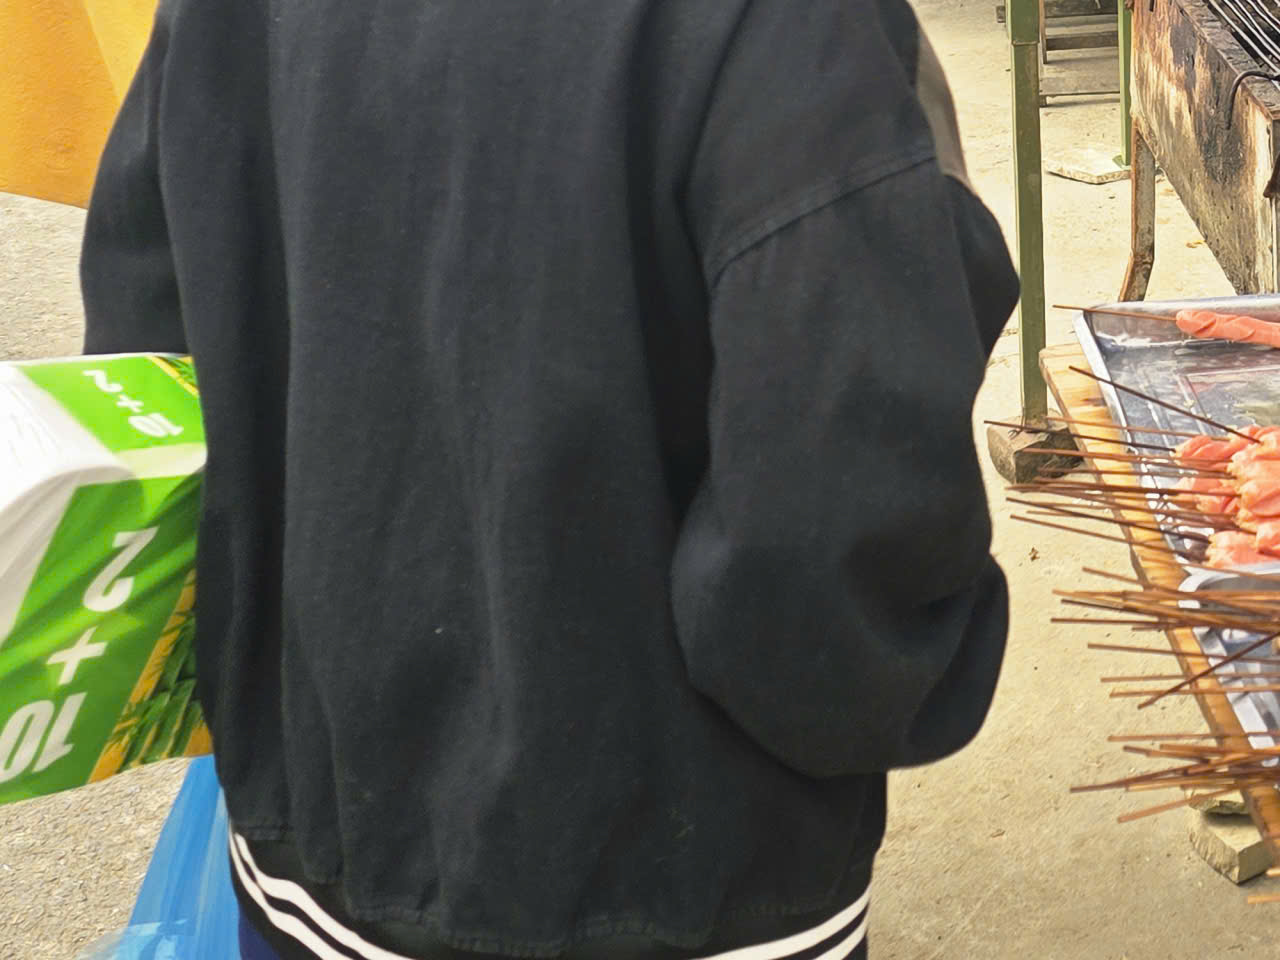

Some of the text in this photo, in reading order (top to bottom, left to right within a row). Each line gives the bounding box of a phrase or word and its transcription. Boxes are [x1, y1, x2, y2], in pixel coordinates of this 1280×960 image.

[82, 369, 124, 393] 2
[128, 412, 184, 438] 10
[0, 691, 88, 784] 10
[83, 524, 161, 613] 2
